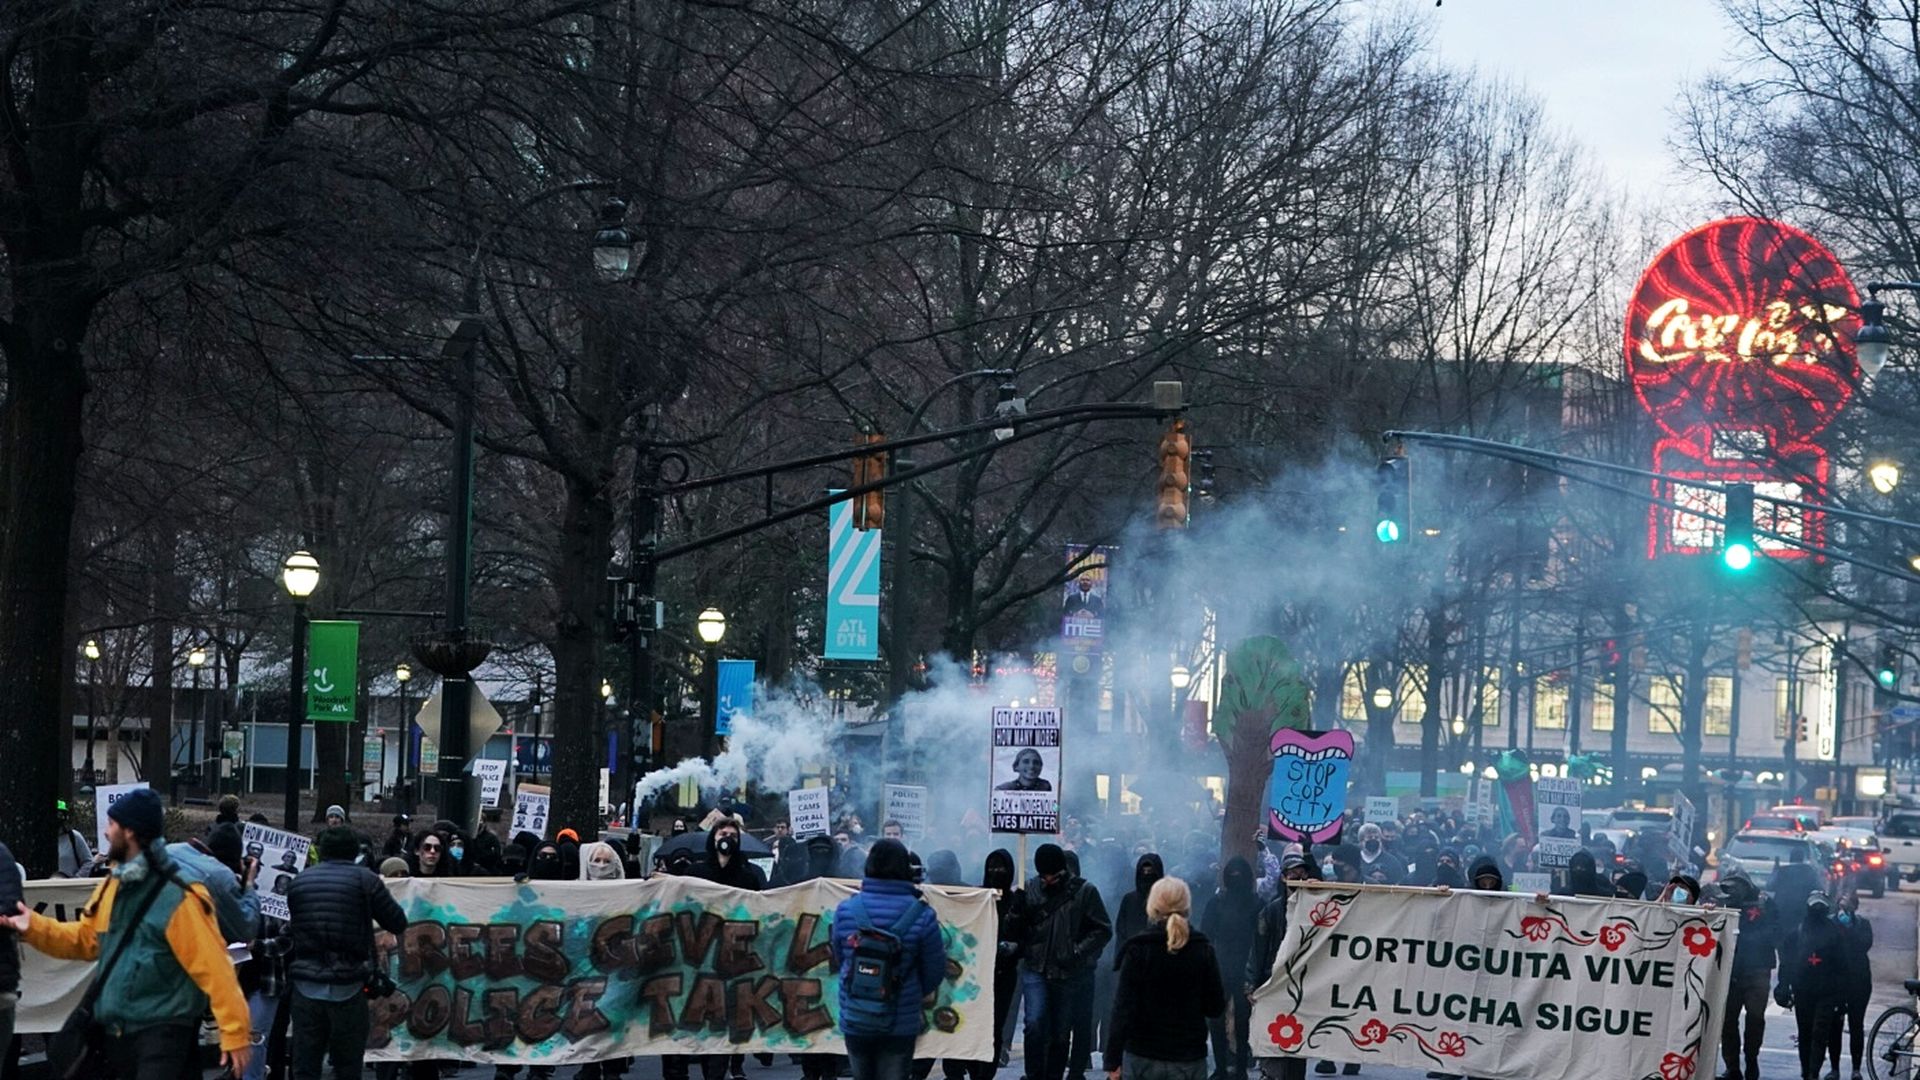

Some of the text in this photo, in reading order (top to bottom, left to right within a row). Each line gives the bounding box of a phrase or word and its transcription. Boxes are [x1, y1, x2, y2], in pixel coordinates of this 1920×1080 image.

[838, 619, 867, 633] ATL
[837, 633, 867, 647] DTN
[997, 711, 1012, 726] CITY
[1015, 711, 1023, 726] OF
[996, 729, 1058, 746] HOW MANY MORE?
[481, 764, 499, 772] STOP
[522, 764, 552, 773] POLIC
[1287, 760, 1337, 789] STOP
[798, 792, 819, 801] BODY
[892, 791, 918, 799] POLICE
[1290, 781, 1324, 802] COP
[798, 802, 820, 811] CAMS
[993, 798, 1013, 813] BLACK
[1281, 796, 1333, 819] CITY
[801, 822, 820, 830] COPS
[993, 815, 1057, 830] LIVES MATTER
[244, 825, 310, 855] HOW MANY MORE?
[261, 904, 289, 918] ATTER
[1328, 933, 1675, 988] TORTUGUITA VIVE
[366, 974, 611, 1052] POLICE
[642, 971, 836, 1044] TAKE
[1330, 983, 1654, 1037] LA LUCHA SIGUE
